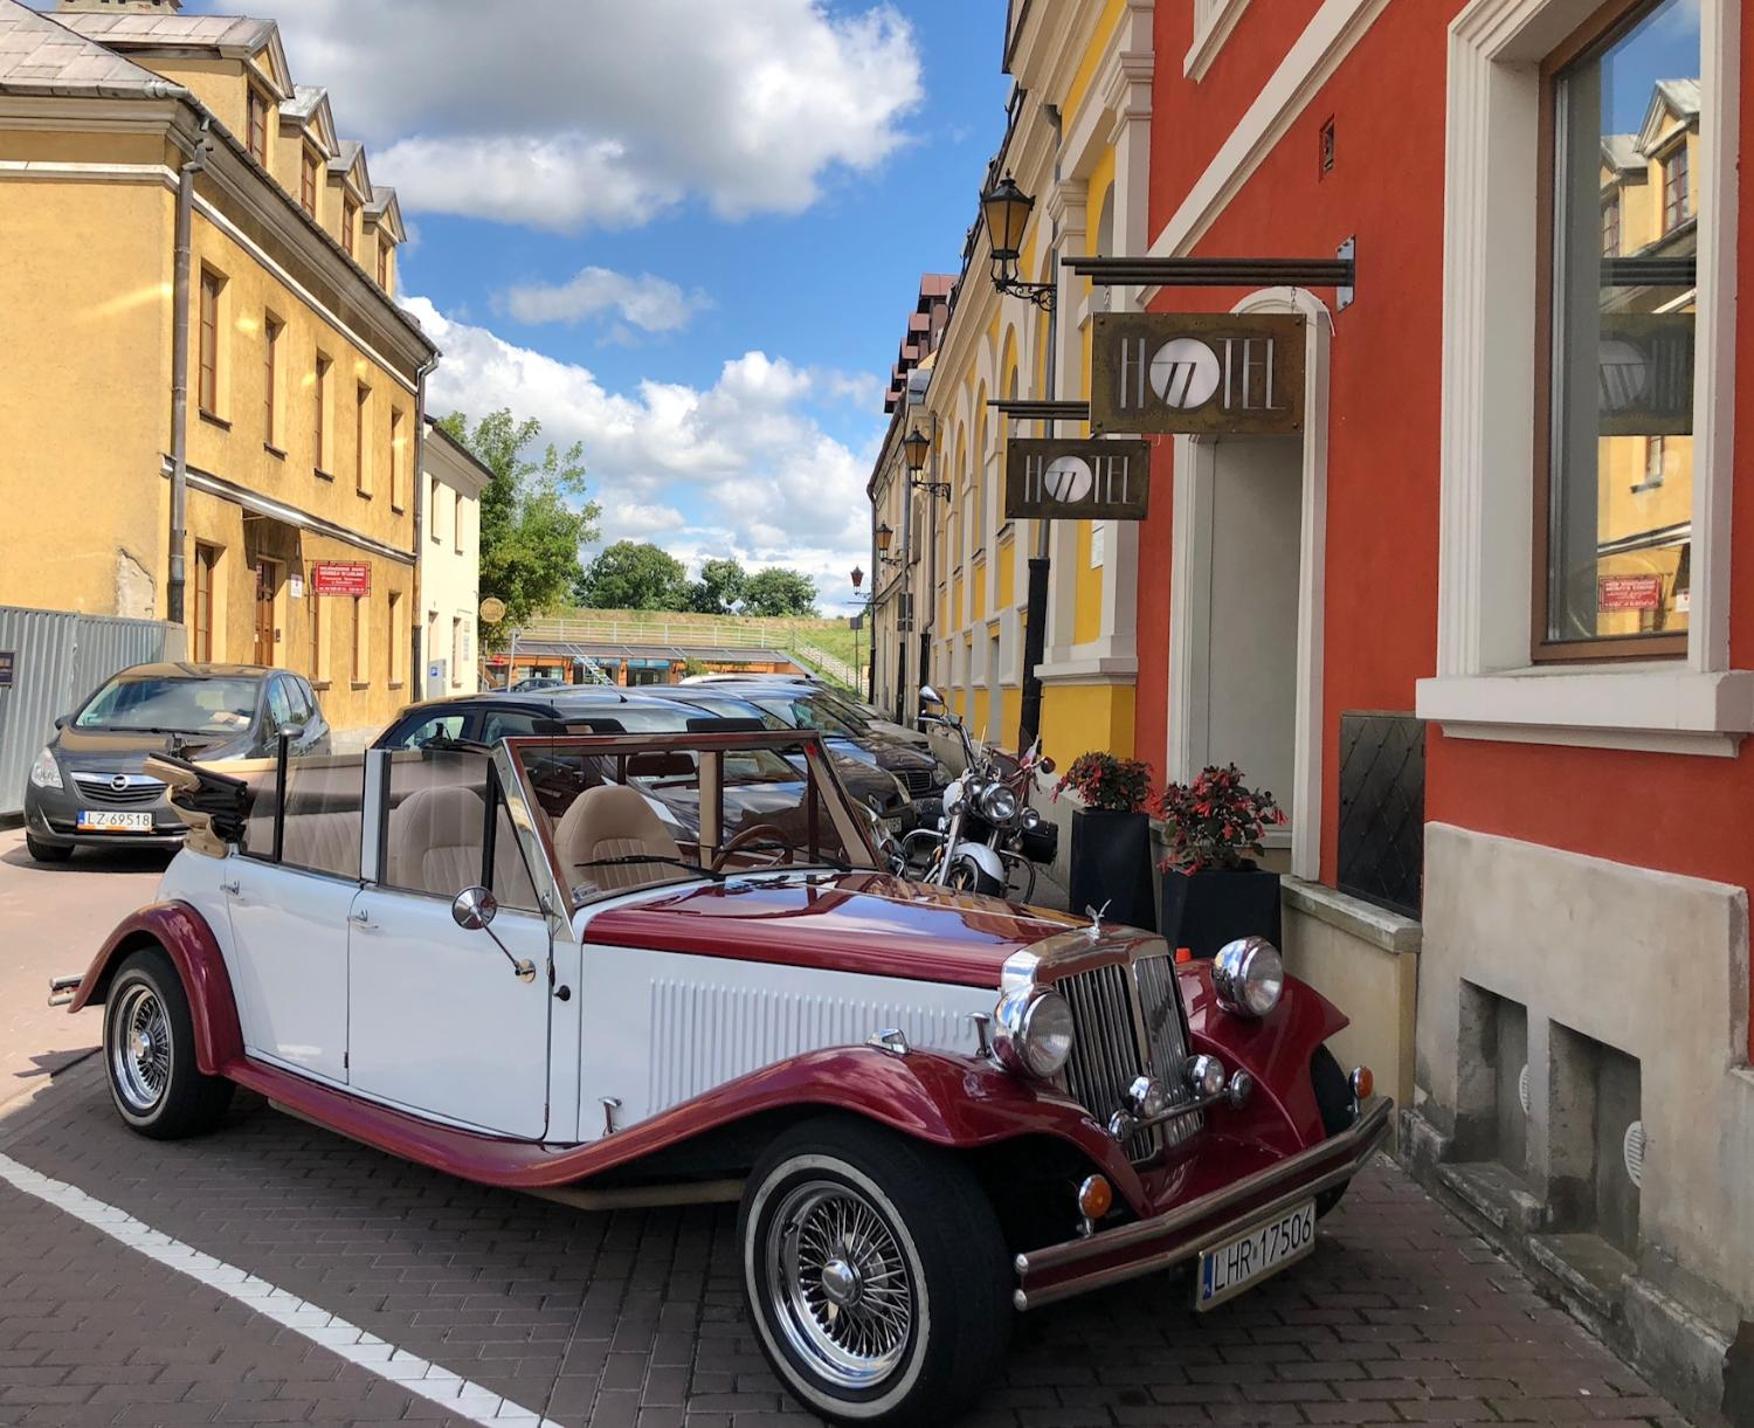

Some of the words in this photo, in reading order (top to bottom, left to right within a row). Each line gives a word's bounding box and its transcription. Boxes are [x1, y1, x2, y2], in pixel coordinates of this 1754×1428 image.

[1119, 336, 1287, 410] HOTEL
[1024, 455, 1136, 505] HOTEL
[87, 813, 106, 826] LZ
[110, 813, 151, 826] 69518
[1214, 1238, 1251, 1292] LHR
[1260, 1206, 1312, 1267] 17506
